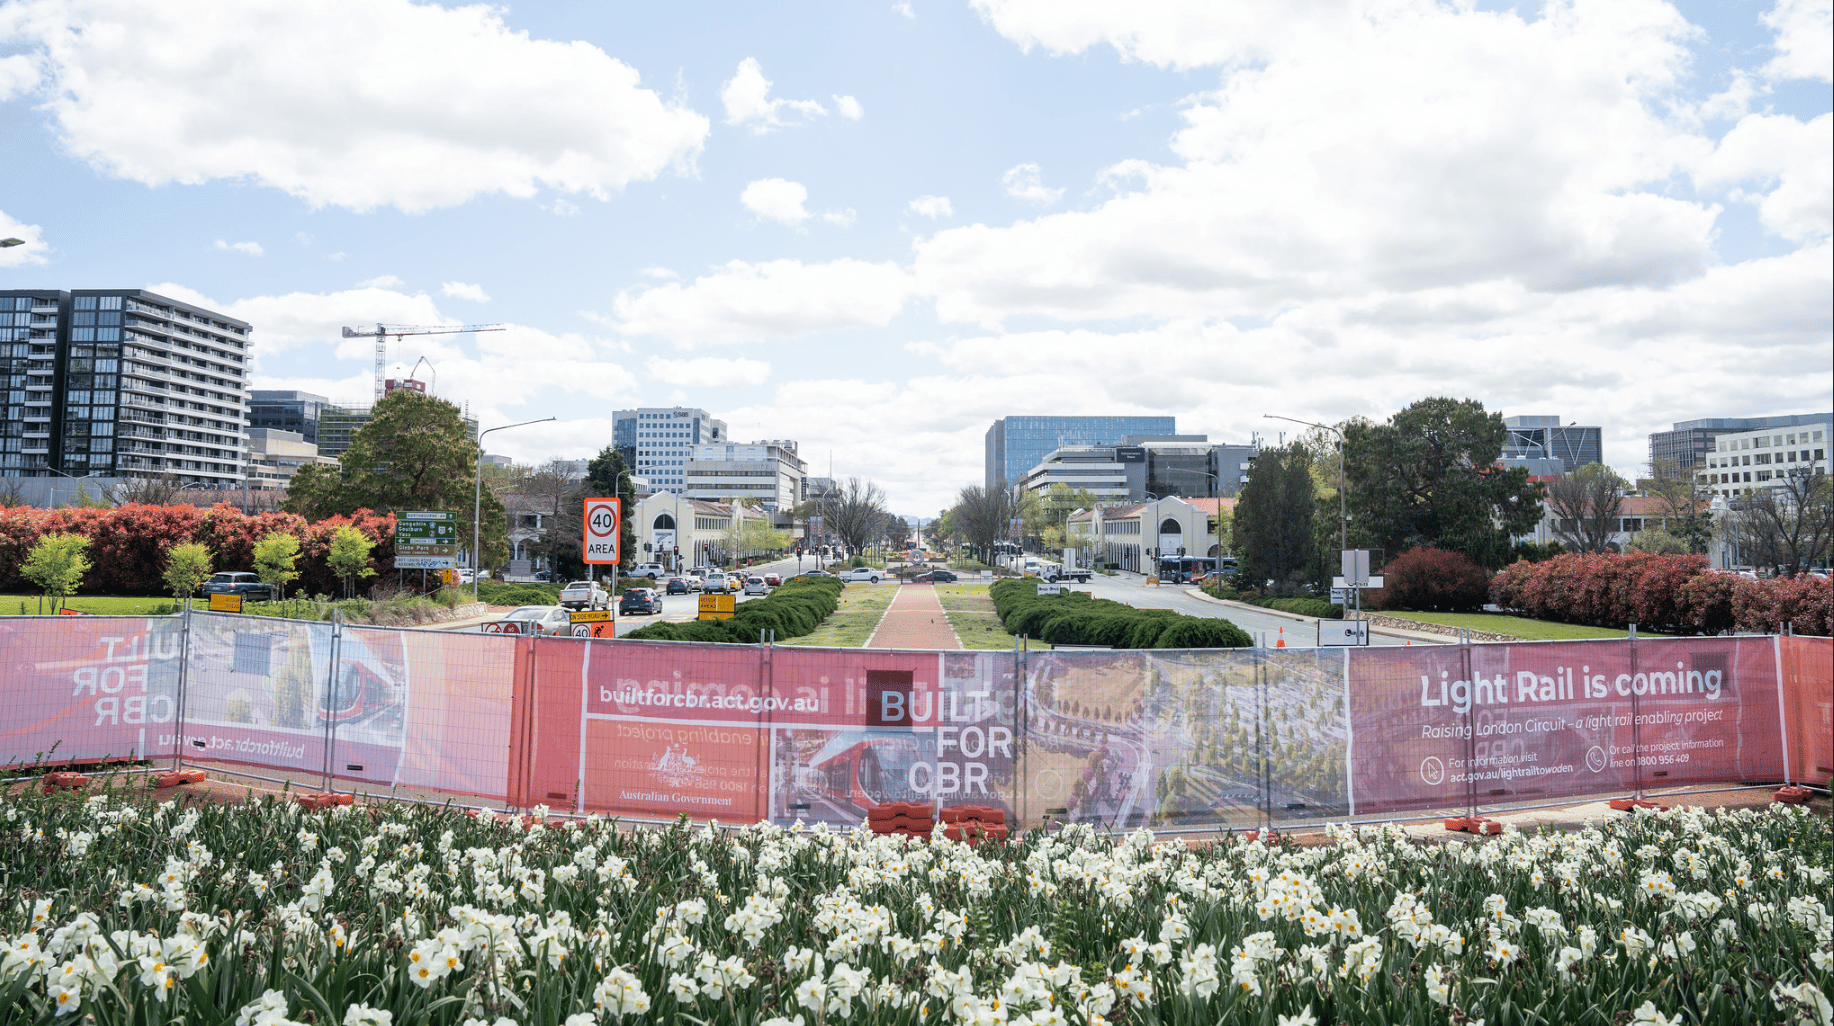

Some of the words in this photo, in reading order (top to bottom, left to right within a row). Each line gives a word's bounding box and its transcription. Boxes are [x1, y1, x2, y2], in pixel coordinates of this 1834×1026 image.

[592, 513, 612, 528] 40
[588, 543, 615, 554] AREA
[575, 629, 589, 637] 40
[1420, 670, 1509, 714] Light
[1517, 666, 1574, 702] Rail
[1583, 665, 1608, 699] is
[1615, 661, 1722, 700] coming
[600, 685, 819, 714] builtforcbr.act.gov.au
[881, 690, 990, 723] BUILT
[1422, 723, 1472, 740] Raising
[1476, 721, 1522, 736] London
[1525, 717, 1565, 733] Circuit
[1575, 719, 1583, 729] a
[1585, 714, 1612, 731] light
[1615, 713, 1633, 726] rail
[1635, 710, 1684, 726] enabling
[1684, 708, 1723, 725] project
[937, 726, 1012, 758] FOR
[1609, 745, 1620, 755] Or
[1622, 743, 1635, 754] call
[1636, 743, 1649, 753] the
[1650, 742, 1679, 755] project
[1681, 739, 1724, 750] information
[1448, 758, 1465, 769] For
[1467, 754, 1519, 768] information
[1519, 752, 1538, 763] visit
[1609, 758, 1625, 768] line
[1626, 758, 1636, 767] on
[1637, 755, 1657, 766] 1800
[1658, 755, 1674, 765] 956
[1675, 753, 1690, 763] 409
[909, 761, 989, 794] CBR
[1450, 763, 1573, 784] act.gov.au/lightrailtowoden
[619, 789, 669, 801] Australian
[671, 792, 732, 806] Government
